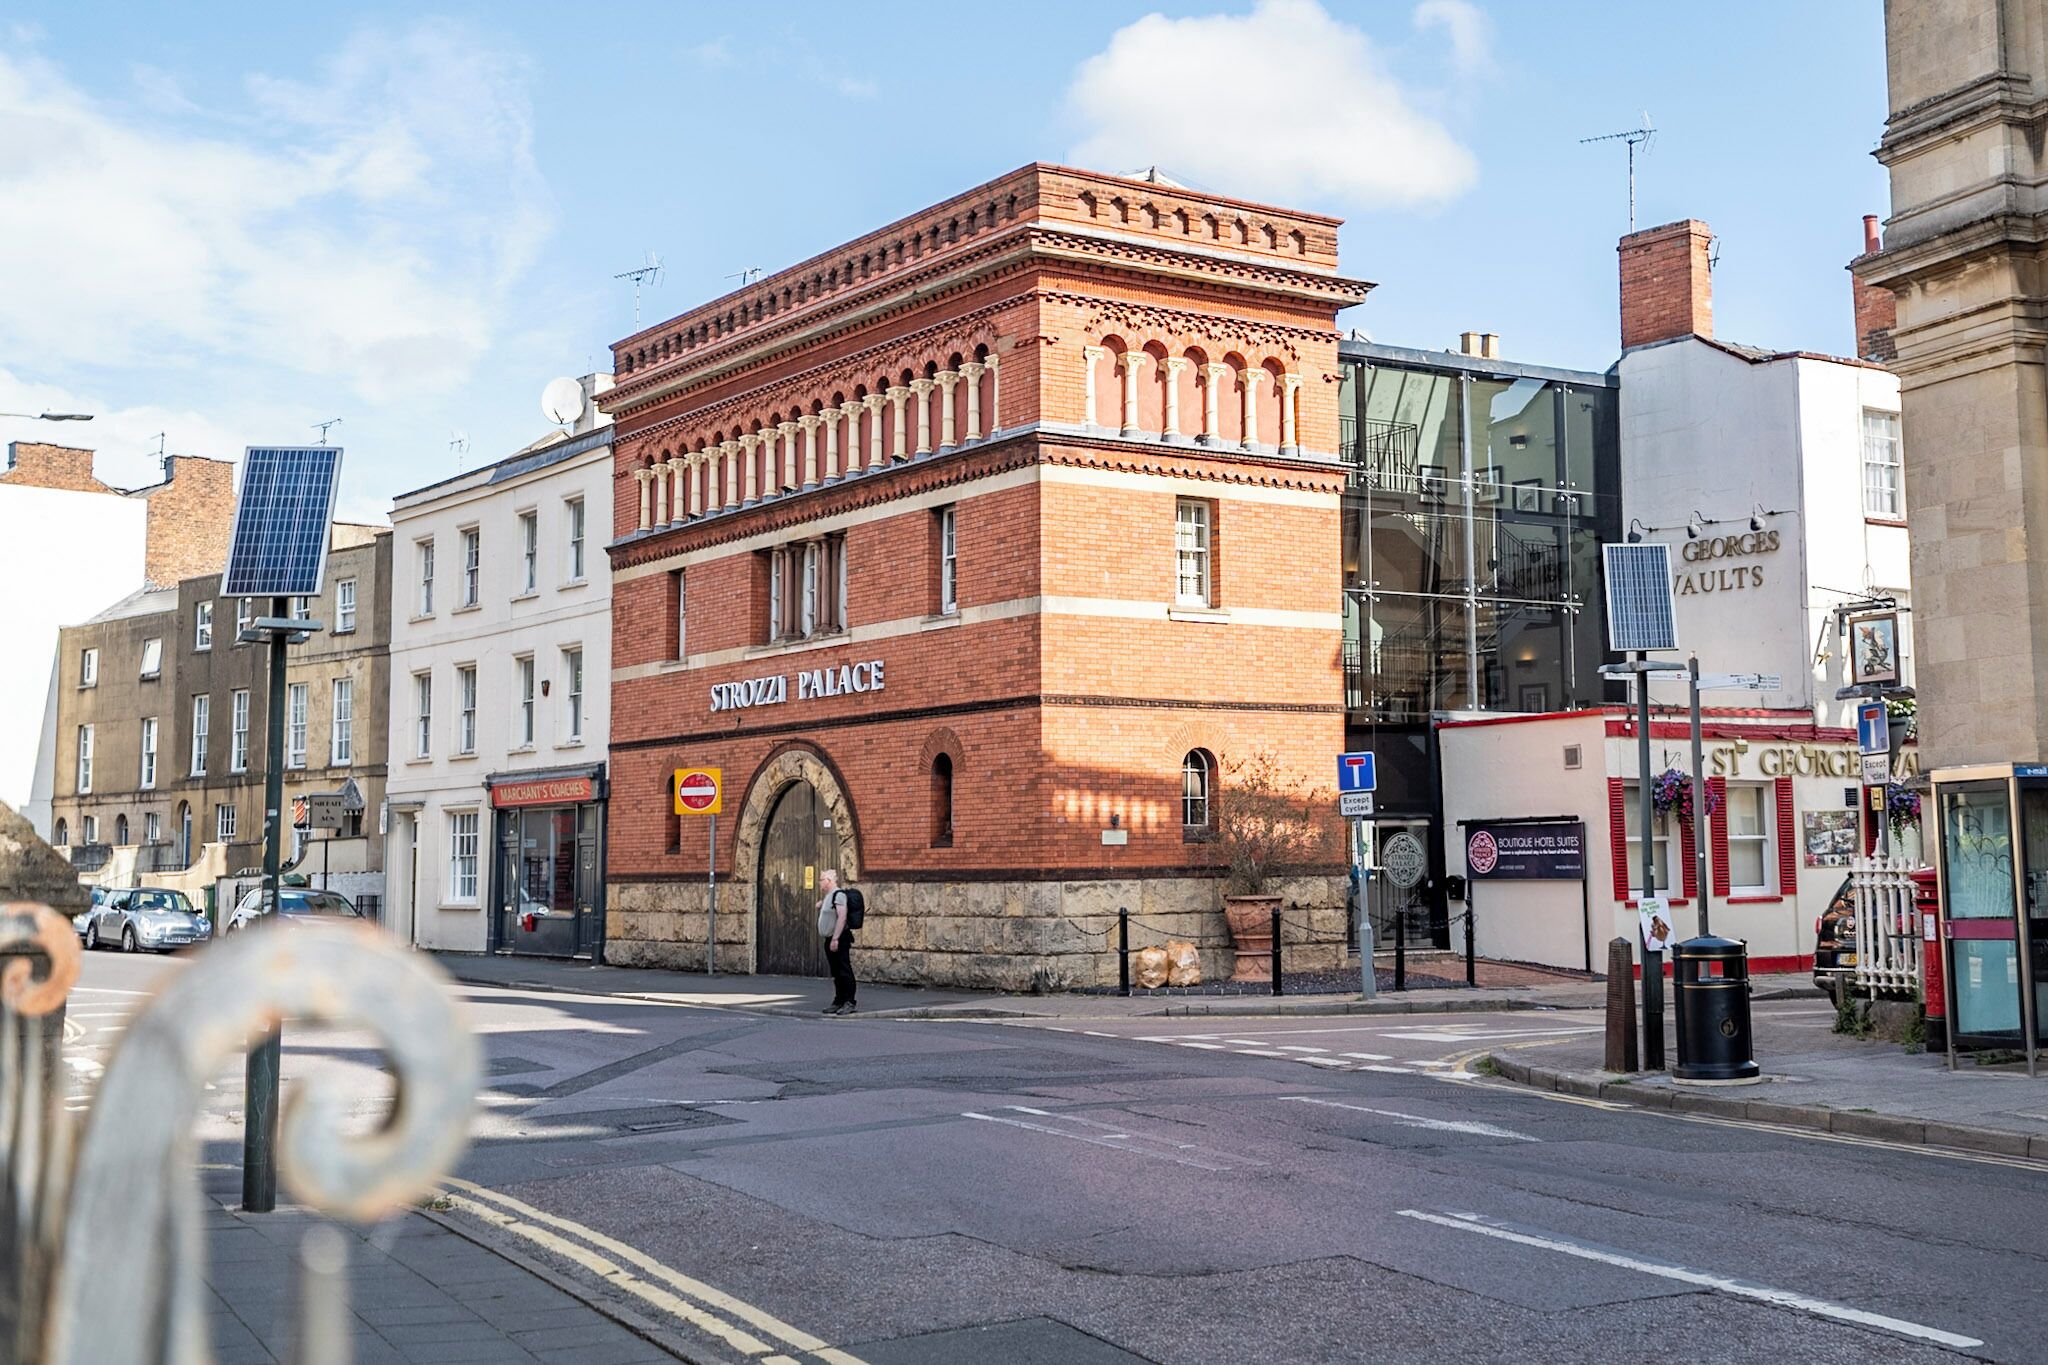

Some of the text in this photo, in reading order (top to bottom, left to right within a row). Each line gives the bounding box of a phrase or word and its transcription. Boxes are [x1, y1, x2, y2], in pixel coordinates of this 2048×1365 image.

[1682, 530, 1780, 562] GEORGES
[710, 660, 885, 712] STROZZI PALACE
[1711, 747, 1742, 776] ST
[1760, 747, 1863, 778] GEORGE
[1865, 760, 1887, 769] Except
[2026, 766, 2048, 775] e-mail
[500, 782, 585, 800] MARCHANT'S COACHES
[1343, 797, 1370, 805] Except
[1345, 805, 1369, 813] cycles
[1498, 836, 1580, 848] BOUTIQUE HOTEL SUITES
